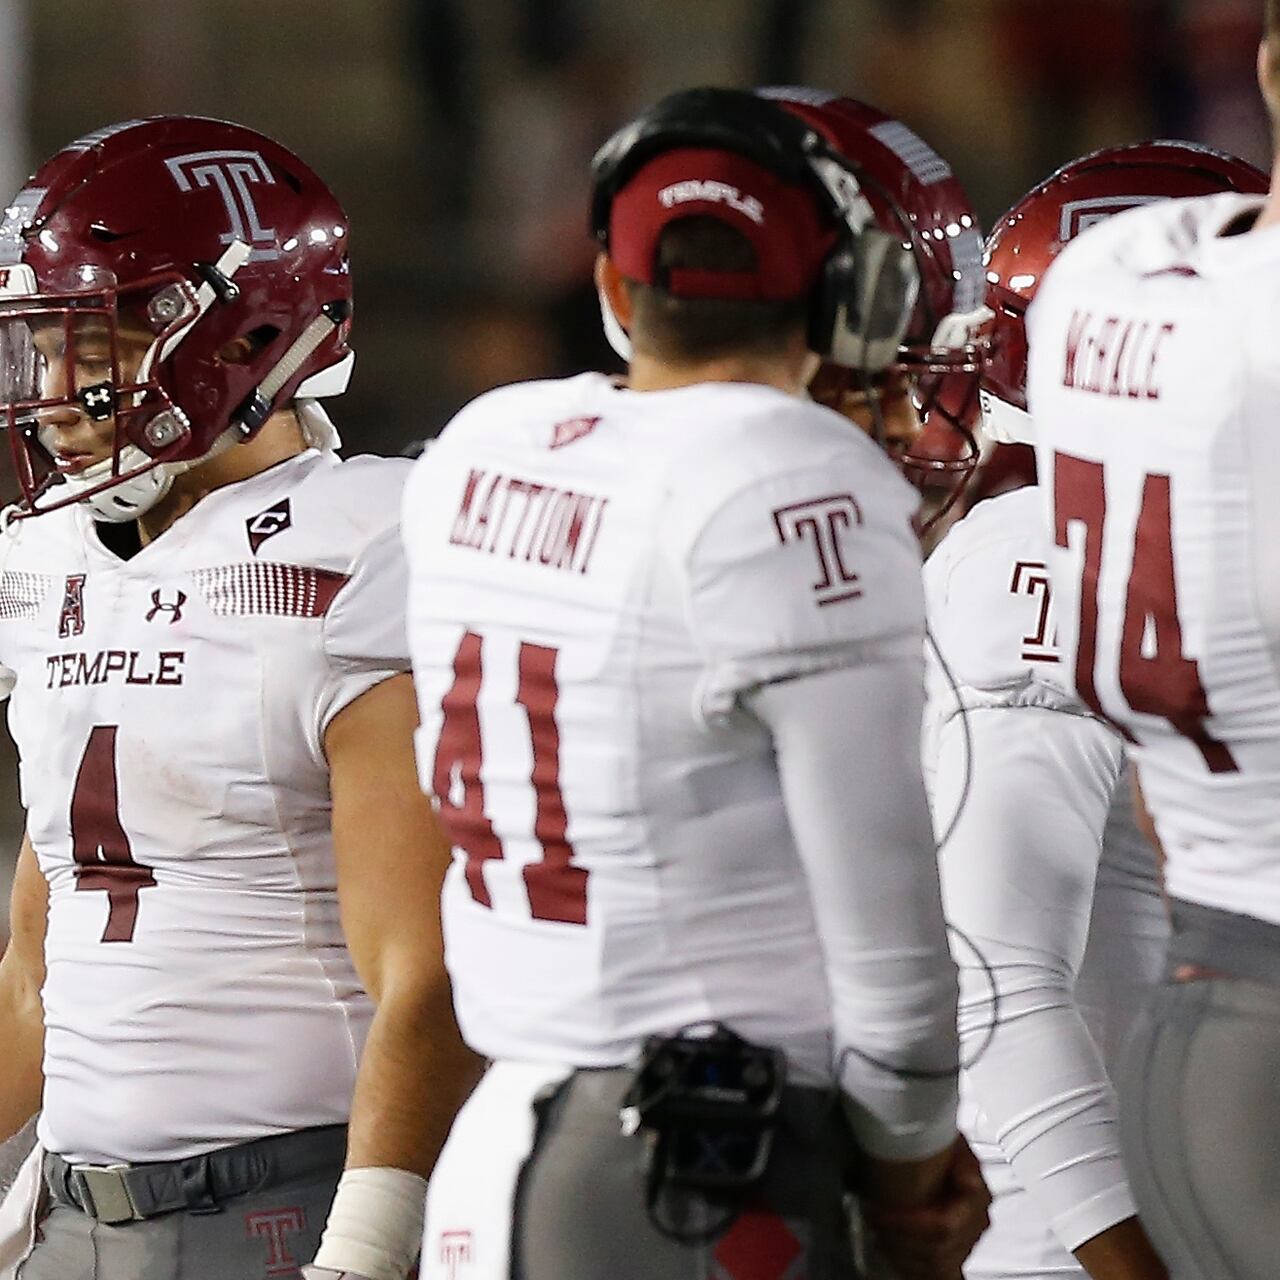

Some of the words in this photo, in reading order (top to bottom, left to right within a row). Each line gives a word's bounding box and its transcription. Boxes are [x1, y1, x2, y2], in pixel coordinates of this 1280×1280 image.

[772, 494, 862, 606] T
[1053, 450, 1240, 773] 74
[46, 649, 186, 689] TEMPLE
[69, 724, 158, 944] 4
[433, 630, 589, 925] 41
[245, 1207, 304, 1277] T
